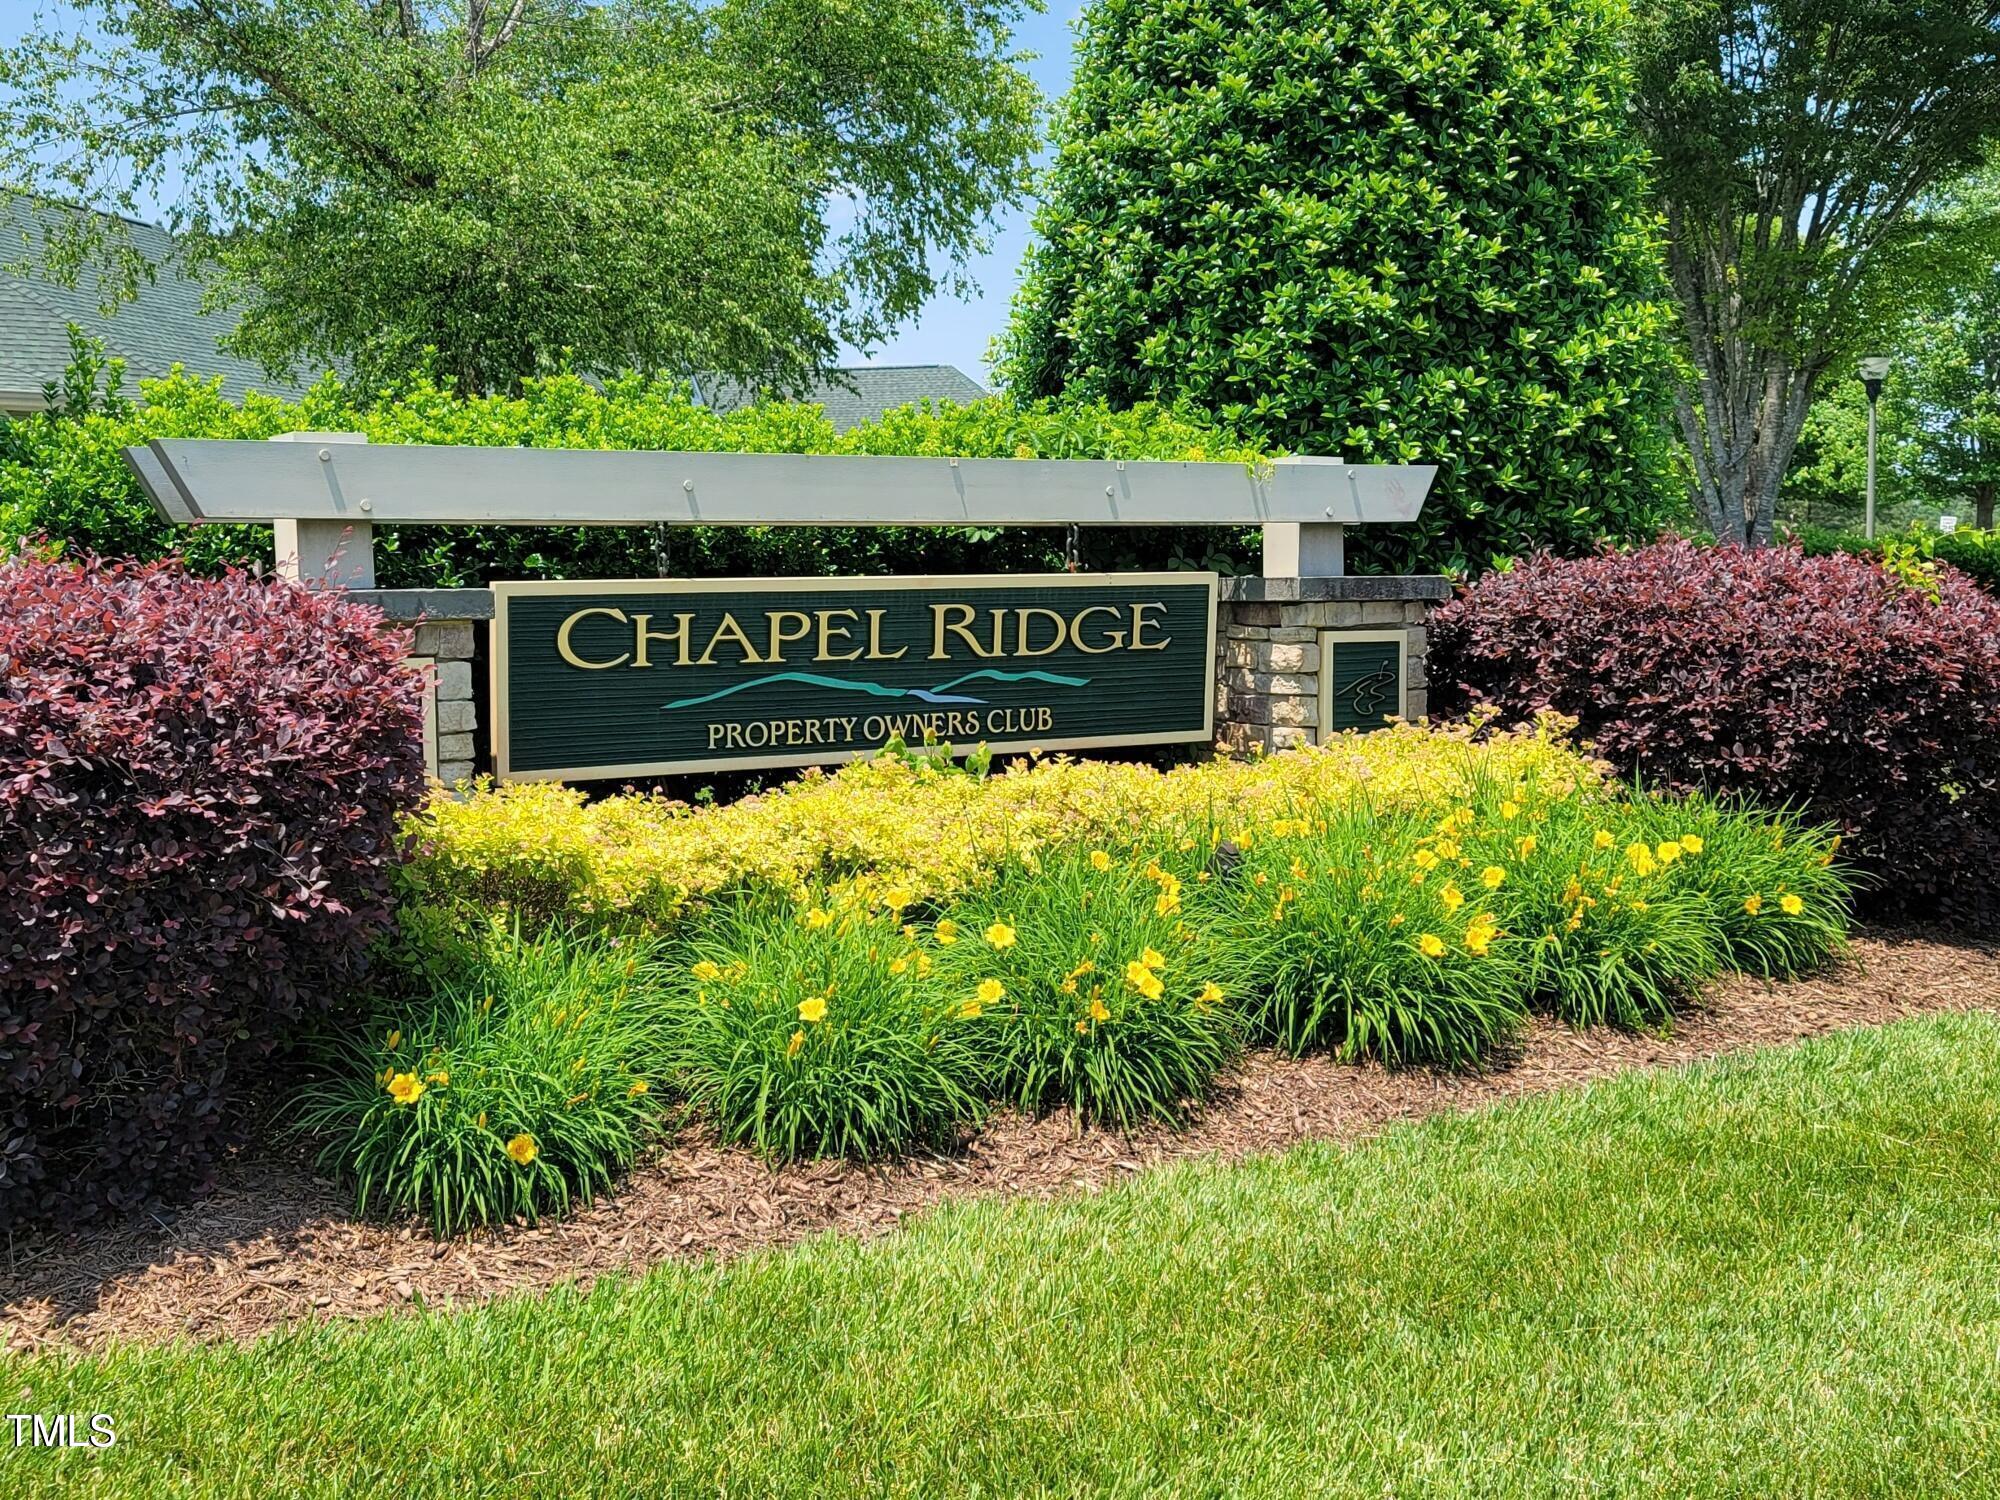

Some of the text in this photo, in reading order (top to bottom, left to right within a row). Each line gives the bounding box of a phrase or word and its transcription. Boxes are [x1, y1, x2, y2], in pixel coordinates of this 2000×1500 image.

[556, 601, 1172, 669] CHAPEL RIDGE
[707, 707, 1053, 750] PROPERTY OWNERS CLUB
